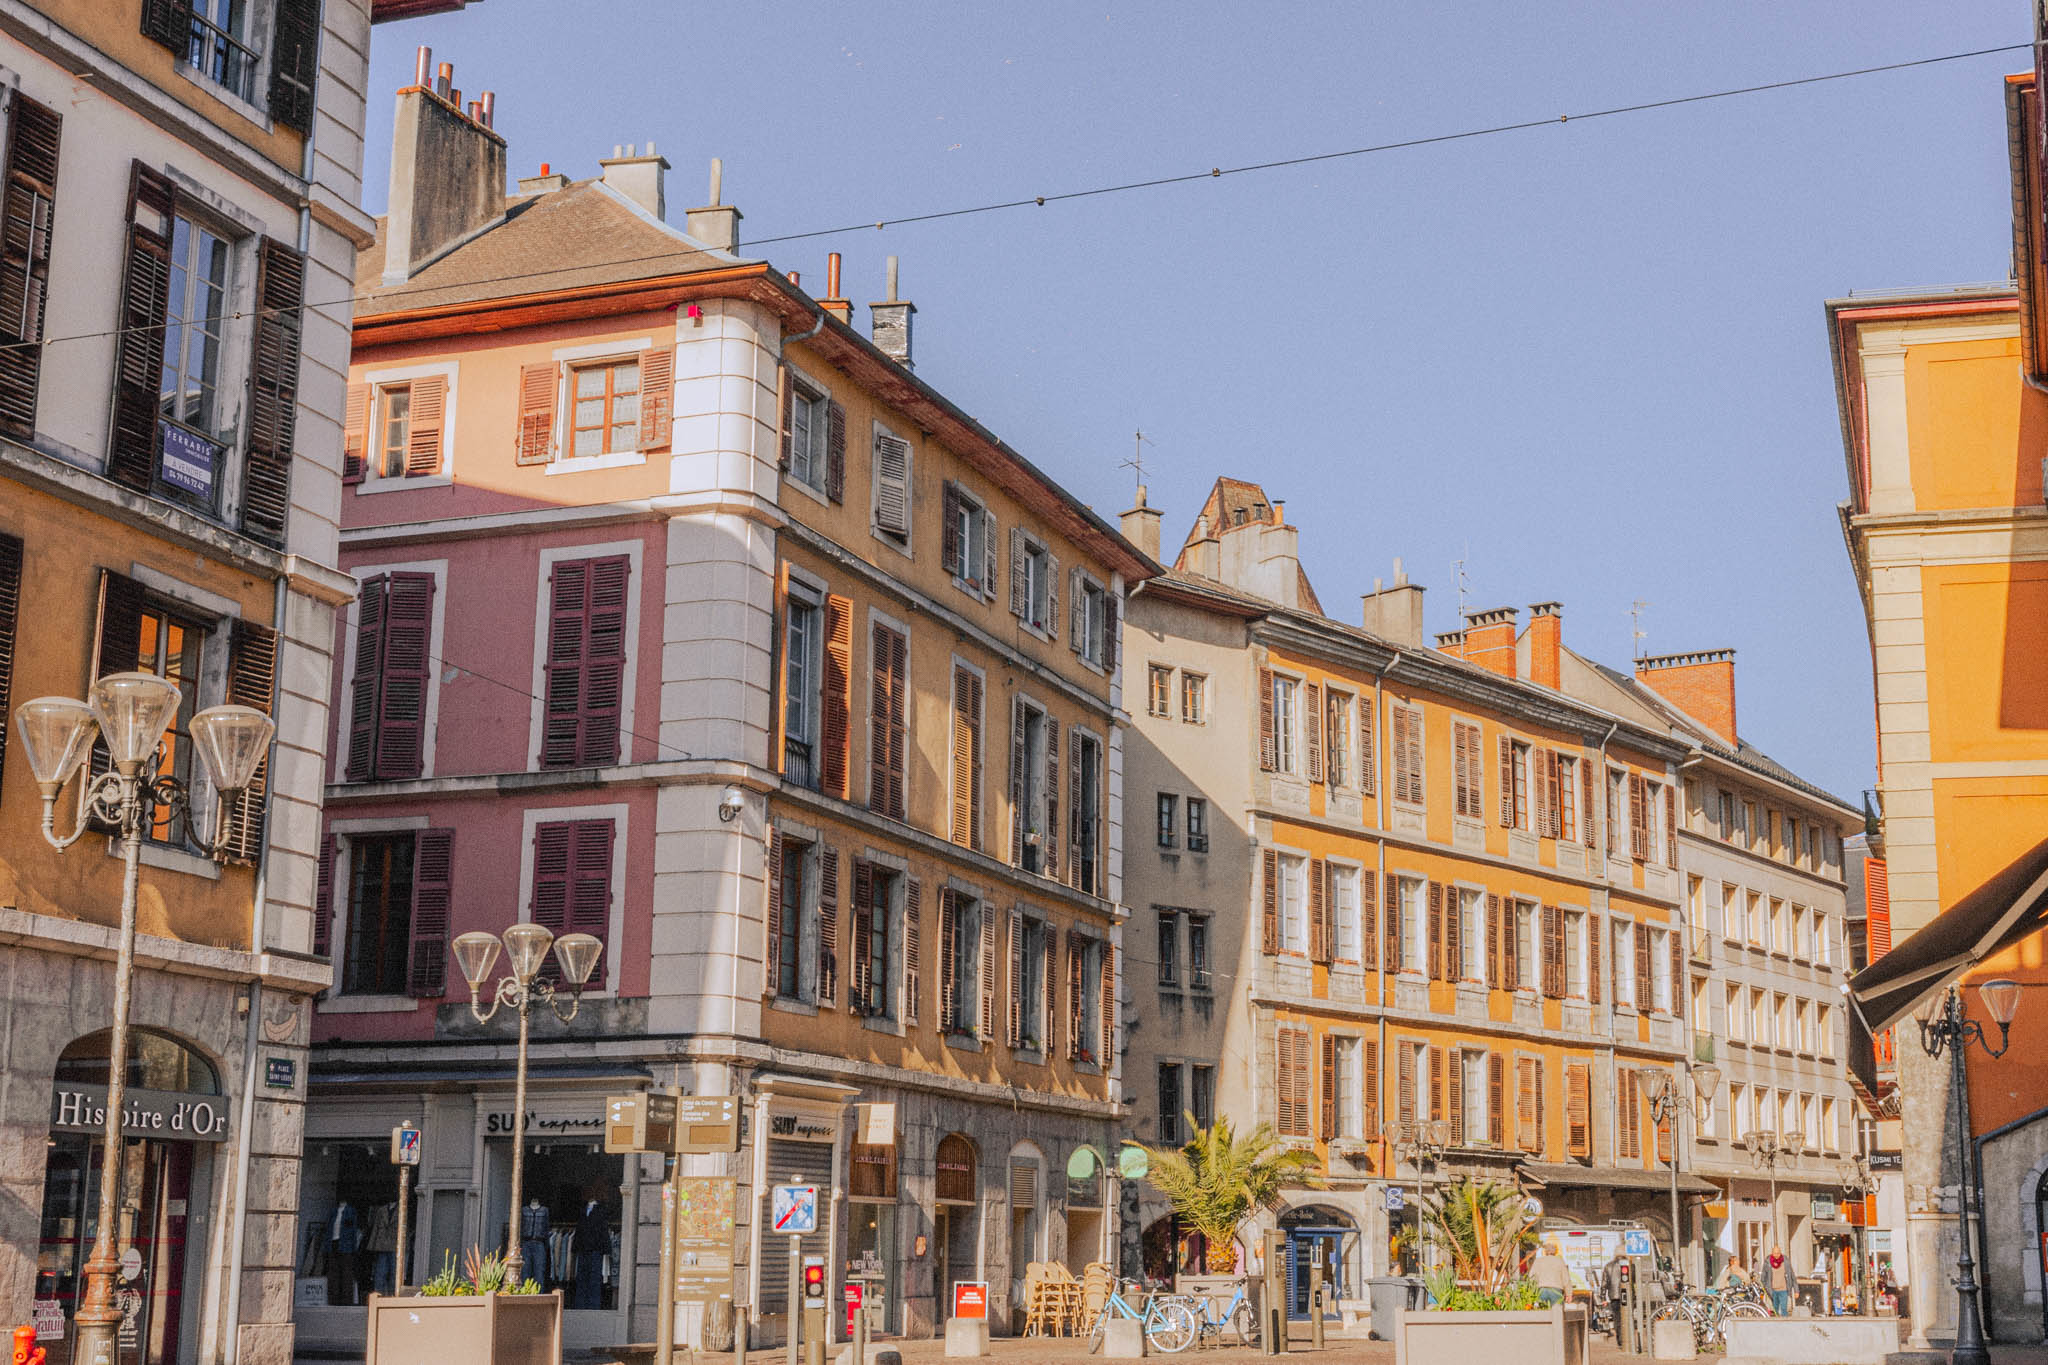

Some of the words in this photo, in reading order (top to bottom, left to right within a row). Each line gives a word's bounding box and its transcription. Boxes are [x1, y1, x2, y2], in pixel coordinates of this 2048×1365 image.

[167, 430, 212, 456] FERRARIS
[178, 462, 204, 479] VENDRE
[171, 1102, 226, 1135] d'Or
[1870, 1155, 1892, 1164] KUSMI
[862, 1250, 875, 1260] THE
[851, 1260, 867, 1270] NEW
[867, 1260, 884, 1270] YORK
